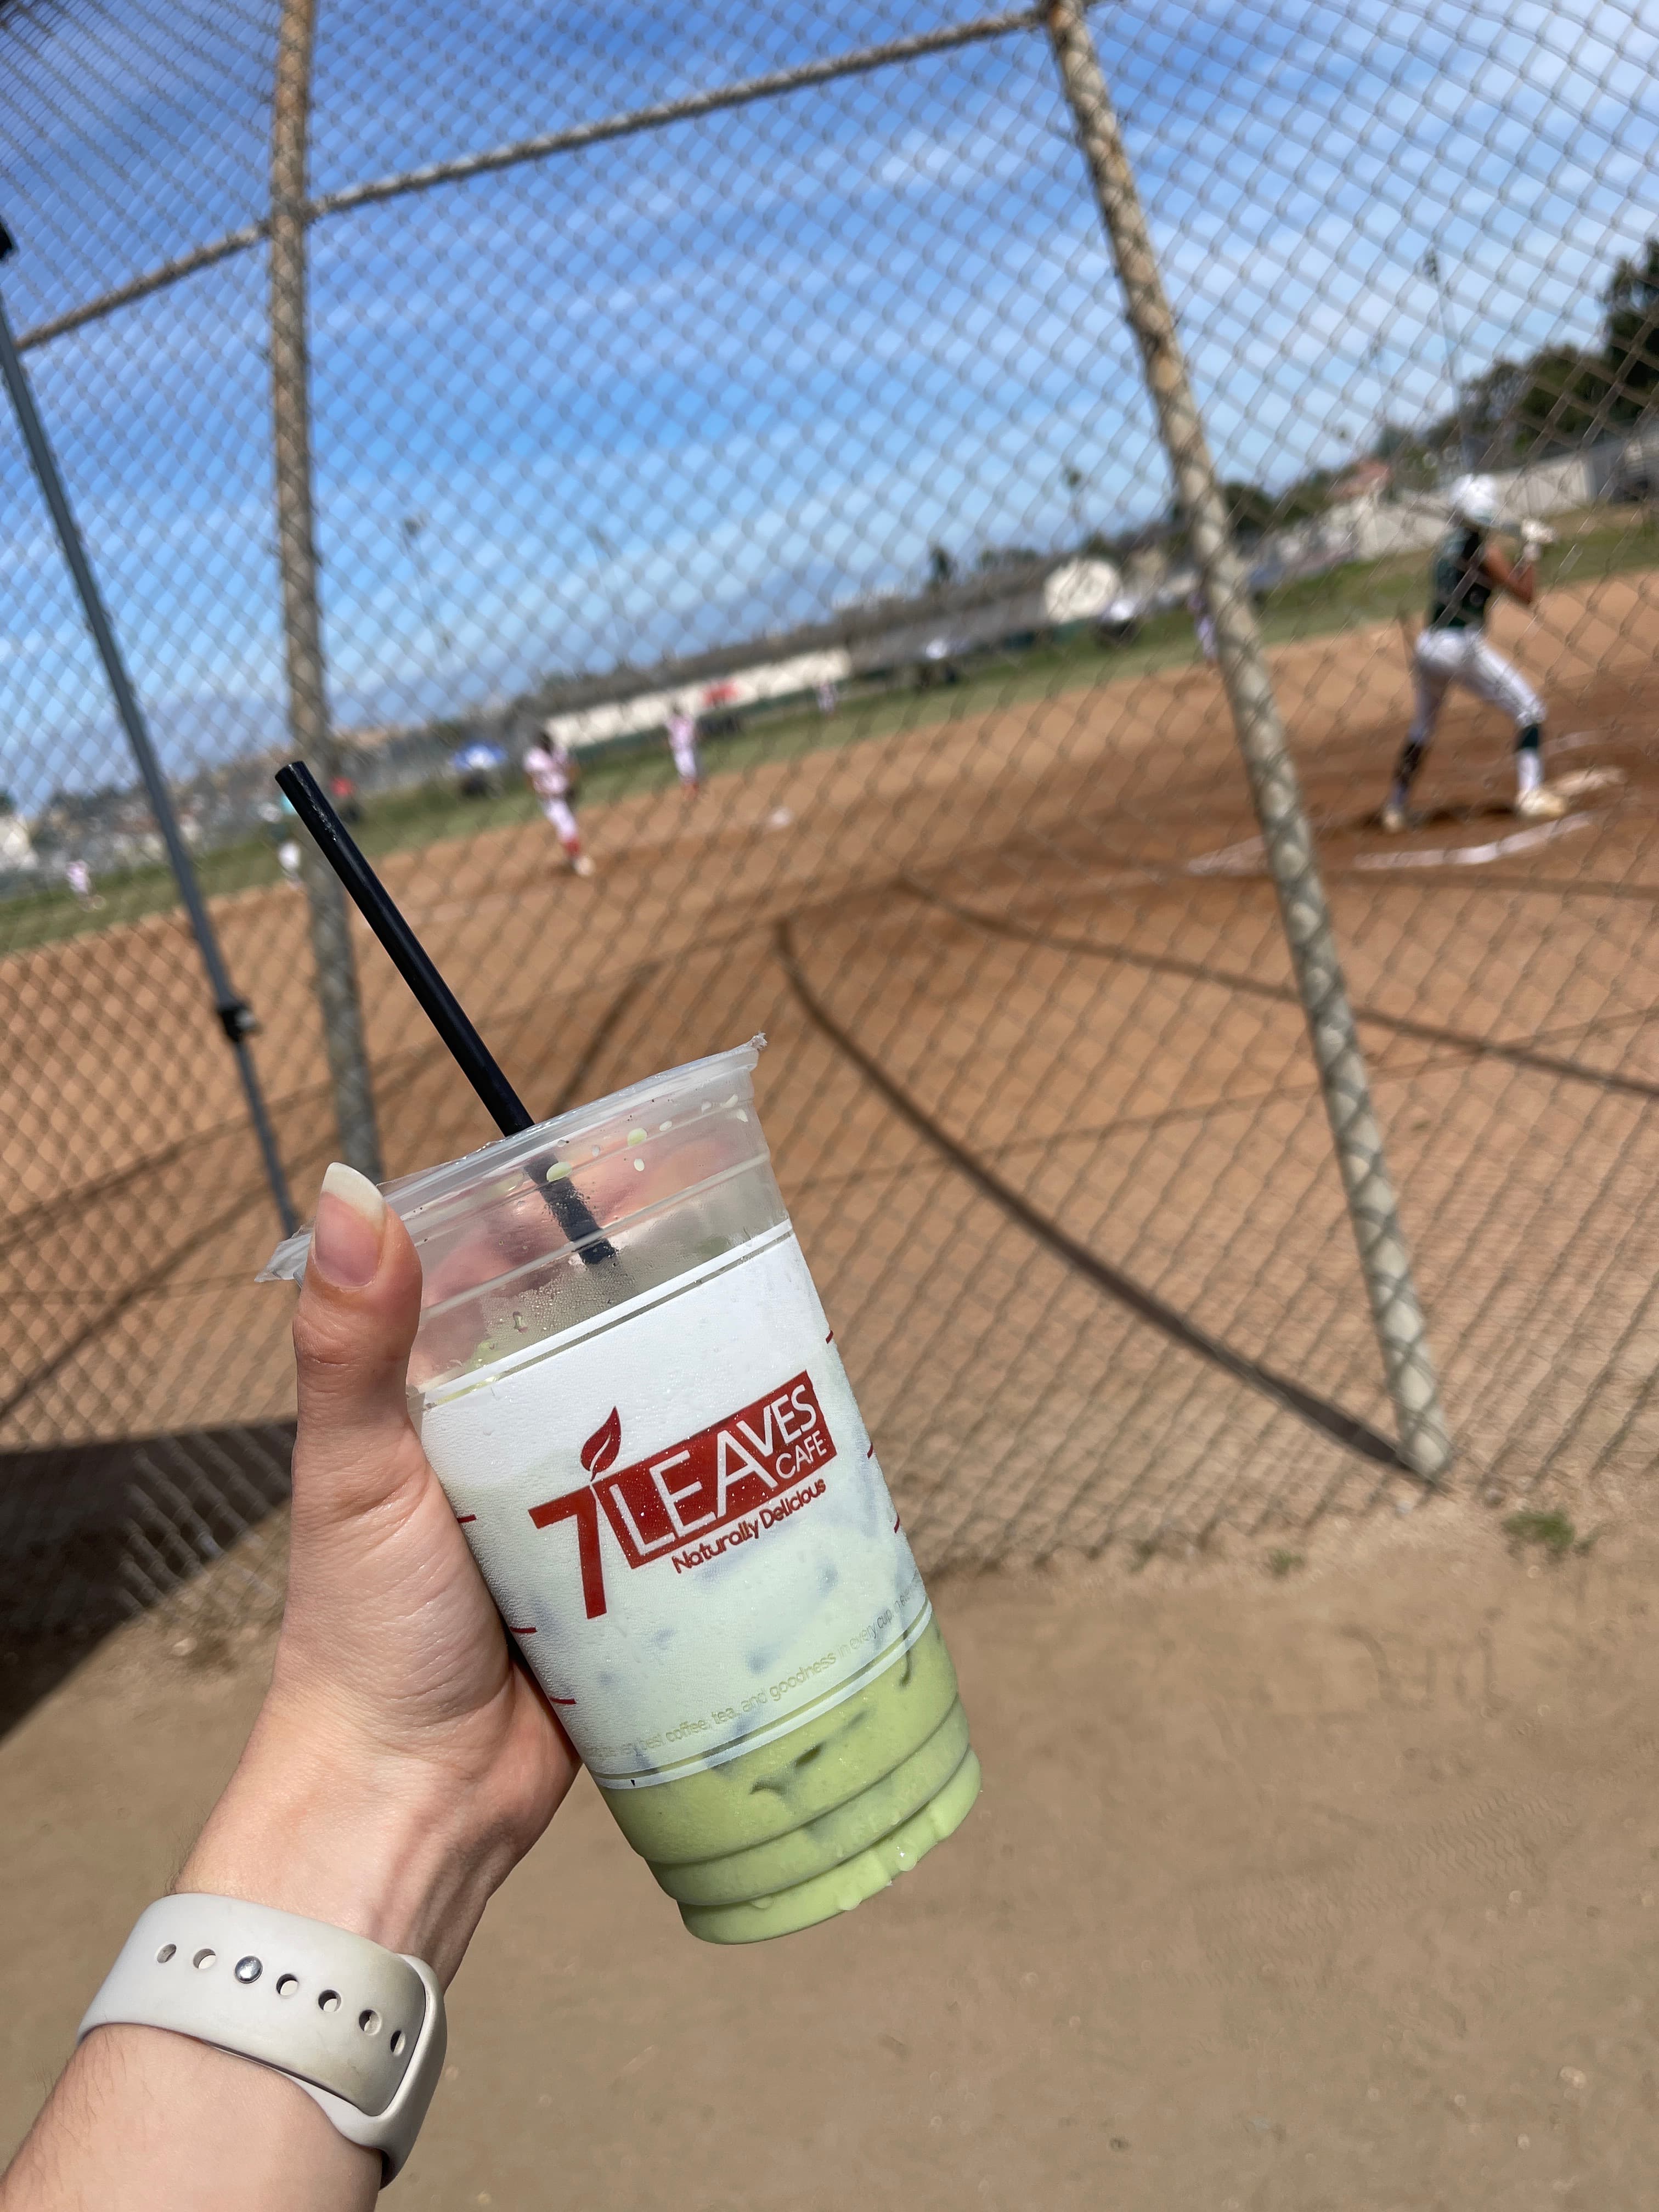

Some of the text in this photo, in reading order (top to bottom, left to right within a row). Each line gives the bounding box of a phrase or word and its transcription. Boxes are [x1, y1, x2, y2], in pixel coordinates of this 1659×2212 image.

[528, 1384, 816, 1619] 7 LEAVES
[776, 1430, 827, 1480] CAFE
[672, 1478, 827, 1574] Naturally Delicious
[741, 1687, 768, 1712] and
[769, 1652, 836, 1701] goodness
[849, 1622, 878, 1650] every
